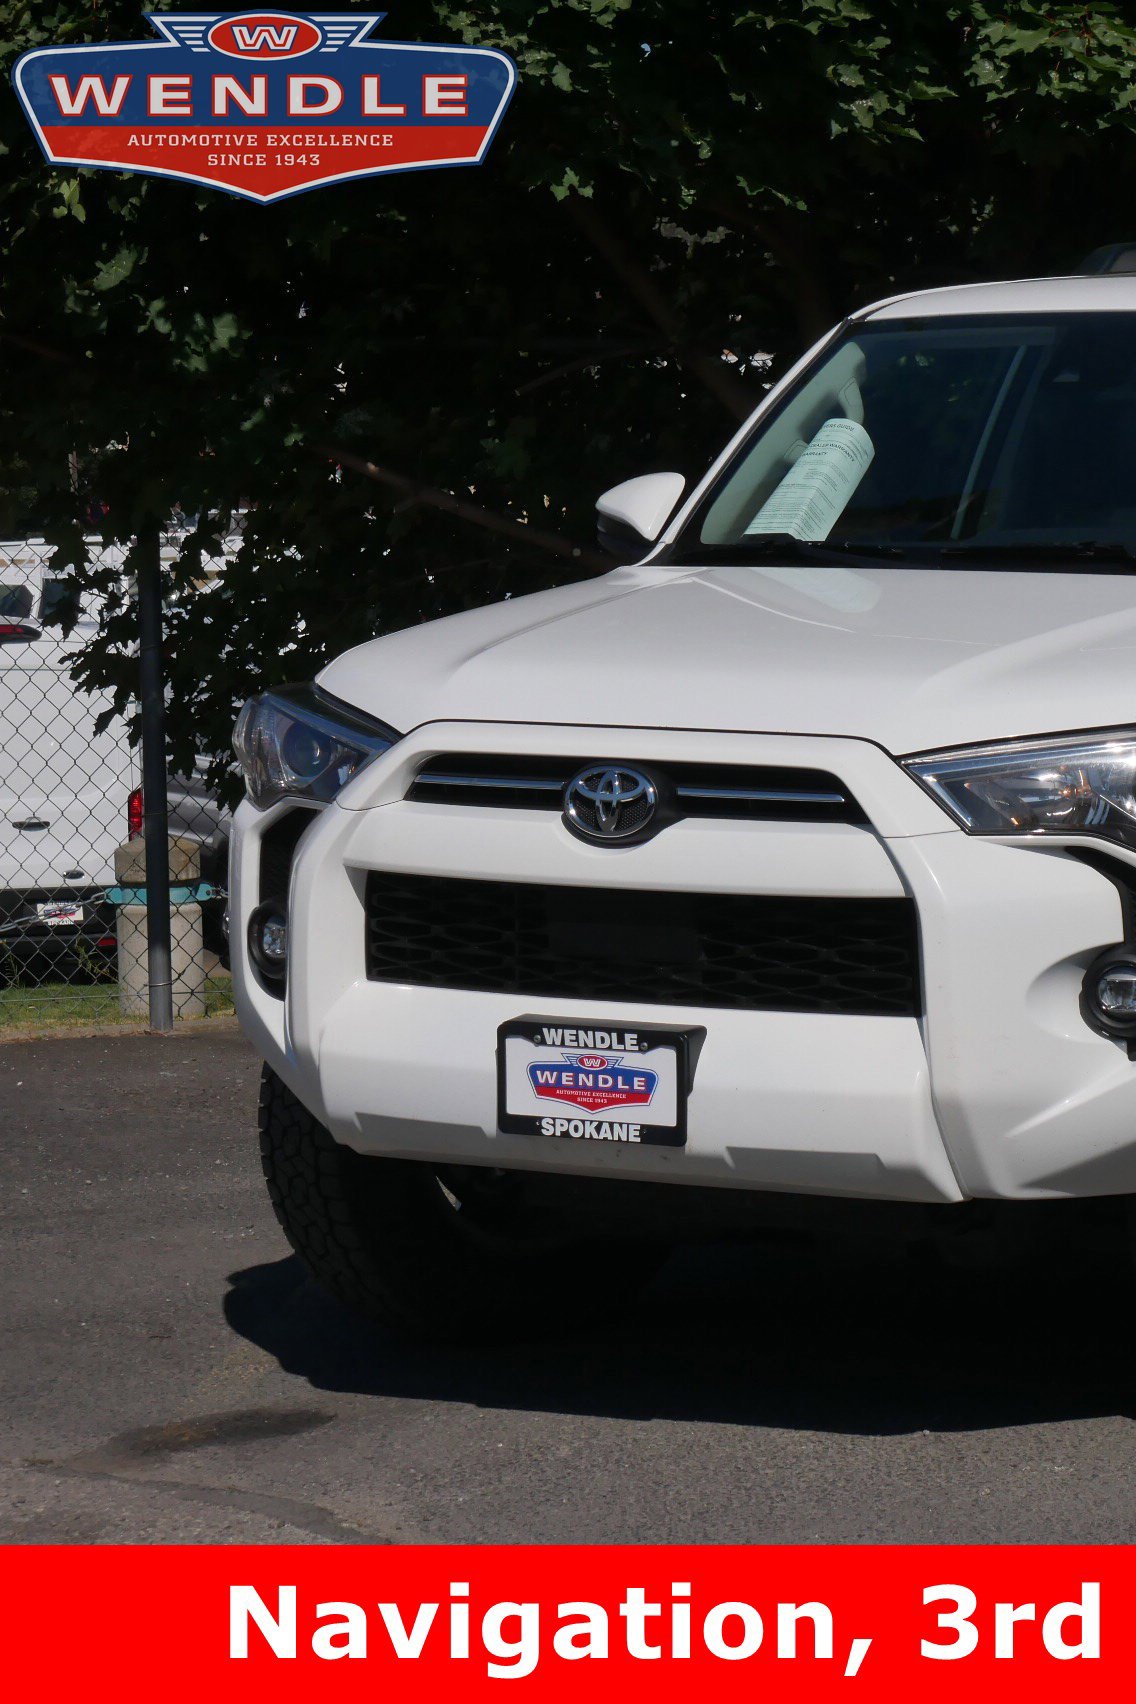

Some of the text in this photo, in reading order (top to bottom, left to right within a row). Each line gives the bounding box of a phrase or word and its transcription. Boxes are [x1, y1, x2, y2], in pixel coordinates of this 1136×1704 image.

[542, 1028, 639, 1051] WENDLE
[536, 1070, 647, 1090] WENDLE
[592, 1091, 627, 1099] EXCELLENCE
[541, 1118, 641, 1142] SPOKANE
